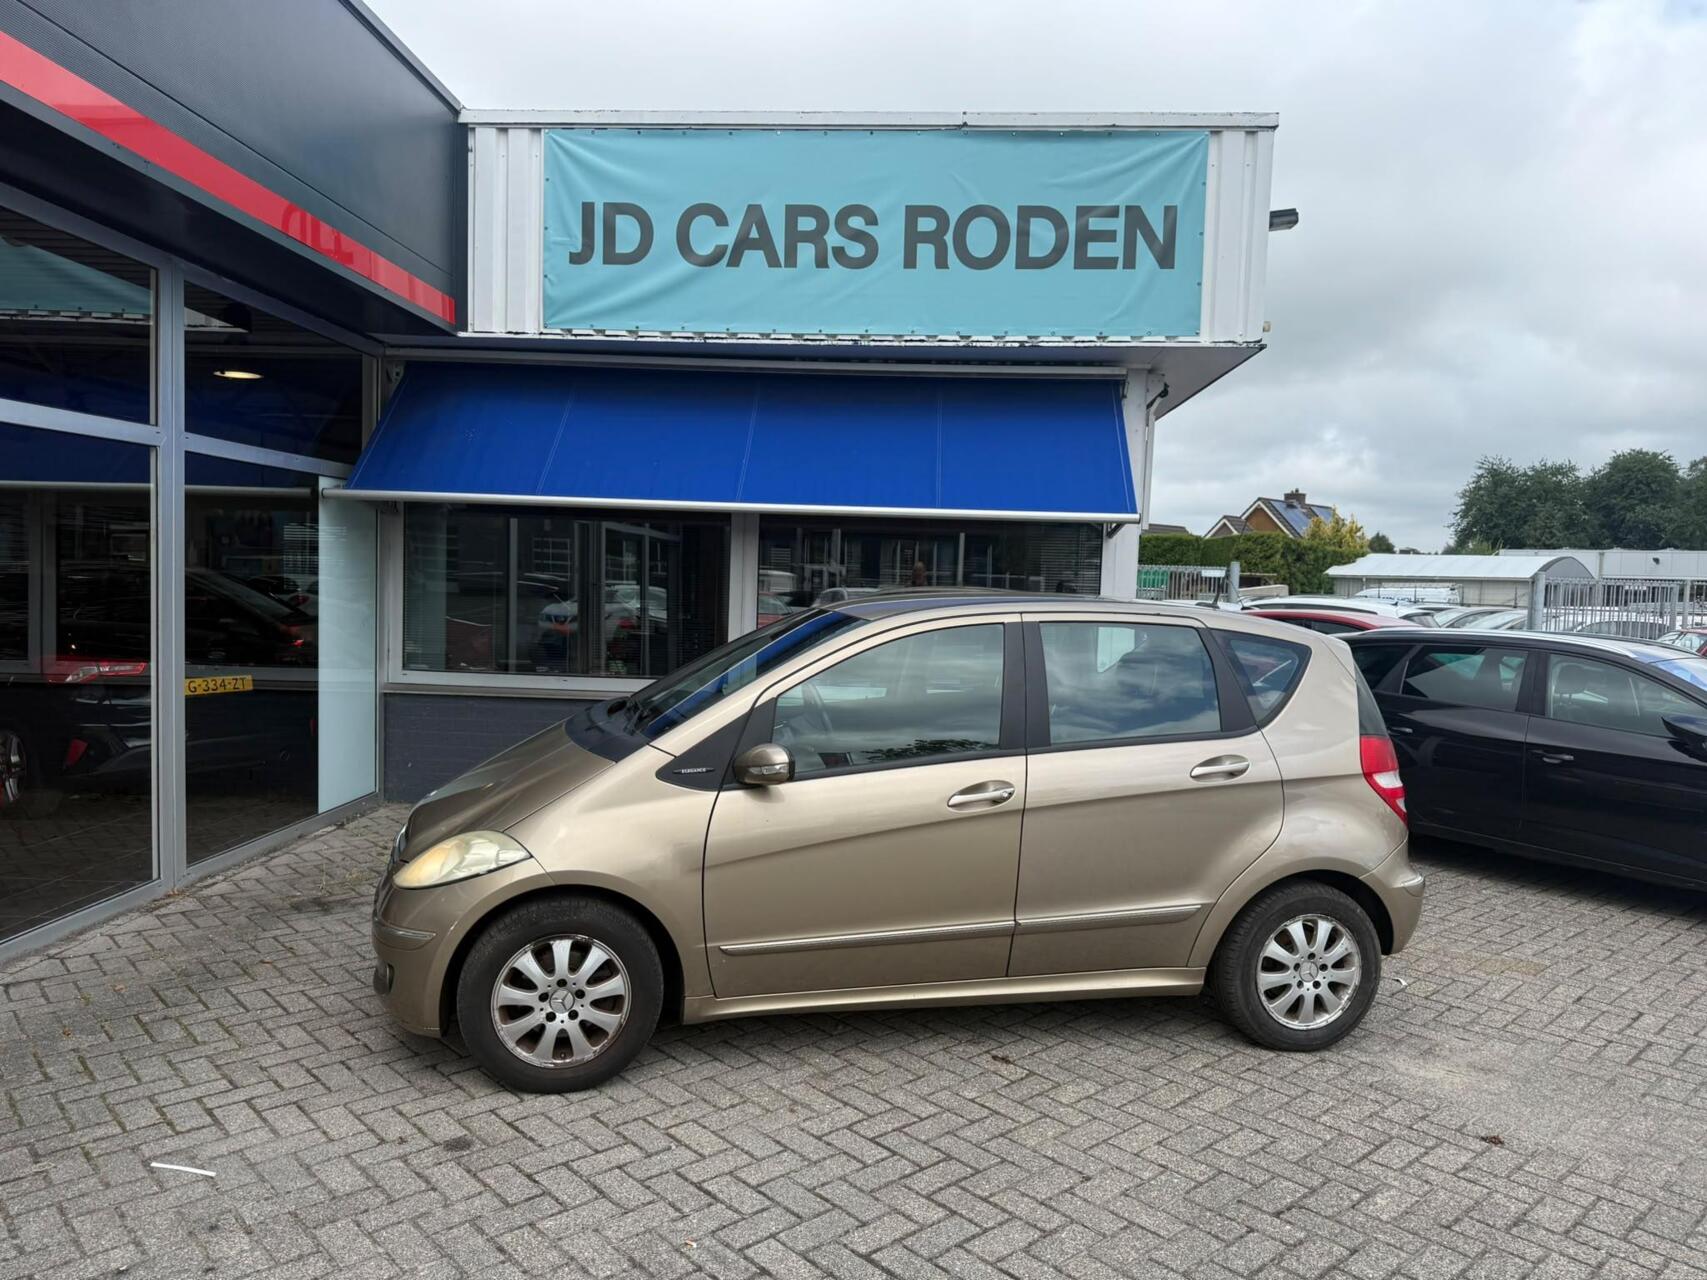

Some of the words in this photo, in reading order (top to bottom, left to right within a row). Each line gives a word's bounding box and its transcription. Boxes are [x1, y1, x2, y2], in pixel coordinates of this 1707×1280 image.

[568, 201, 655, 266] JD
[676, 202, 880, 270] CARS
[903, 204, 1178, 271] RODEN
